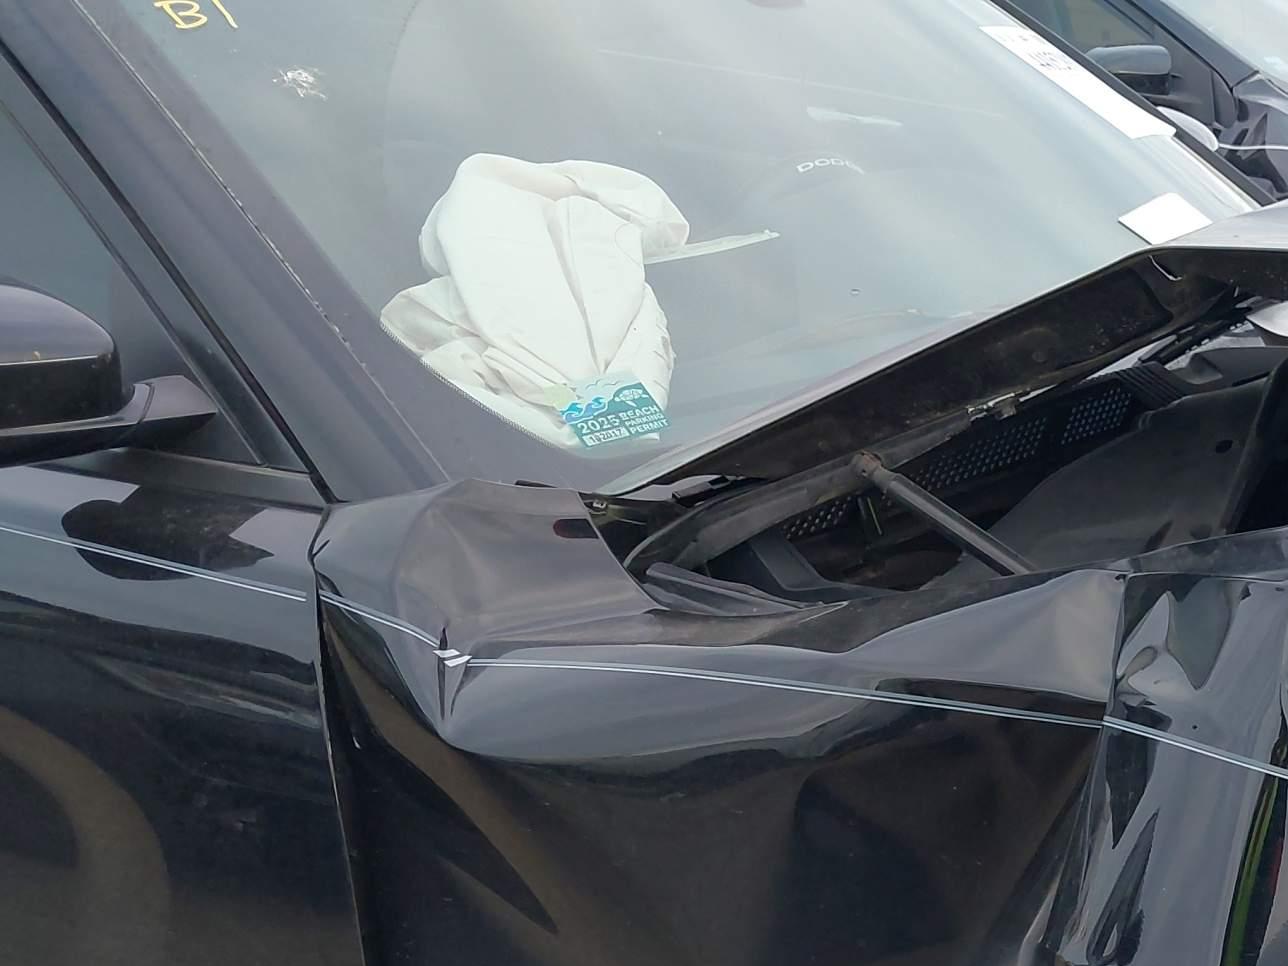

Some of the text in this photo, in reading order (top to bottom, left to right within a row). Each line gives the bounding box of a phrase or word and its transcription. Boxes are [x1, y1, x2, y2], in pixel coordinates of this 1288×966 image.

[619, 404, 660, 421] BEACH
[625, 413, 665, 427] PARKING
[577, 414, 620, 434] 2025
[630, 419, 669, 434] PERMIT
